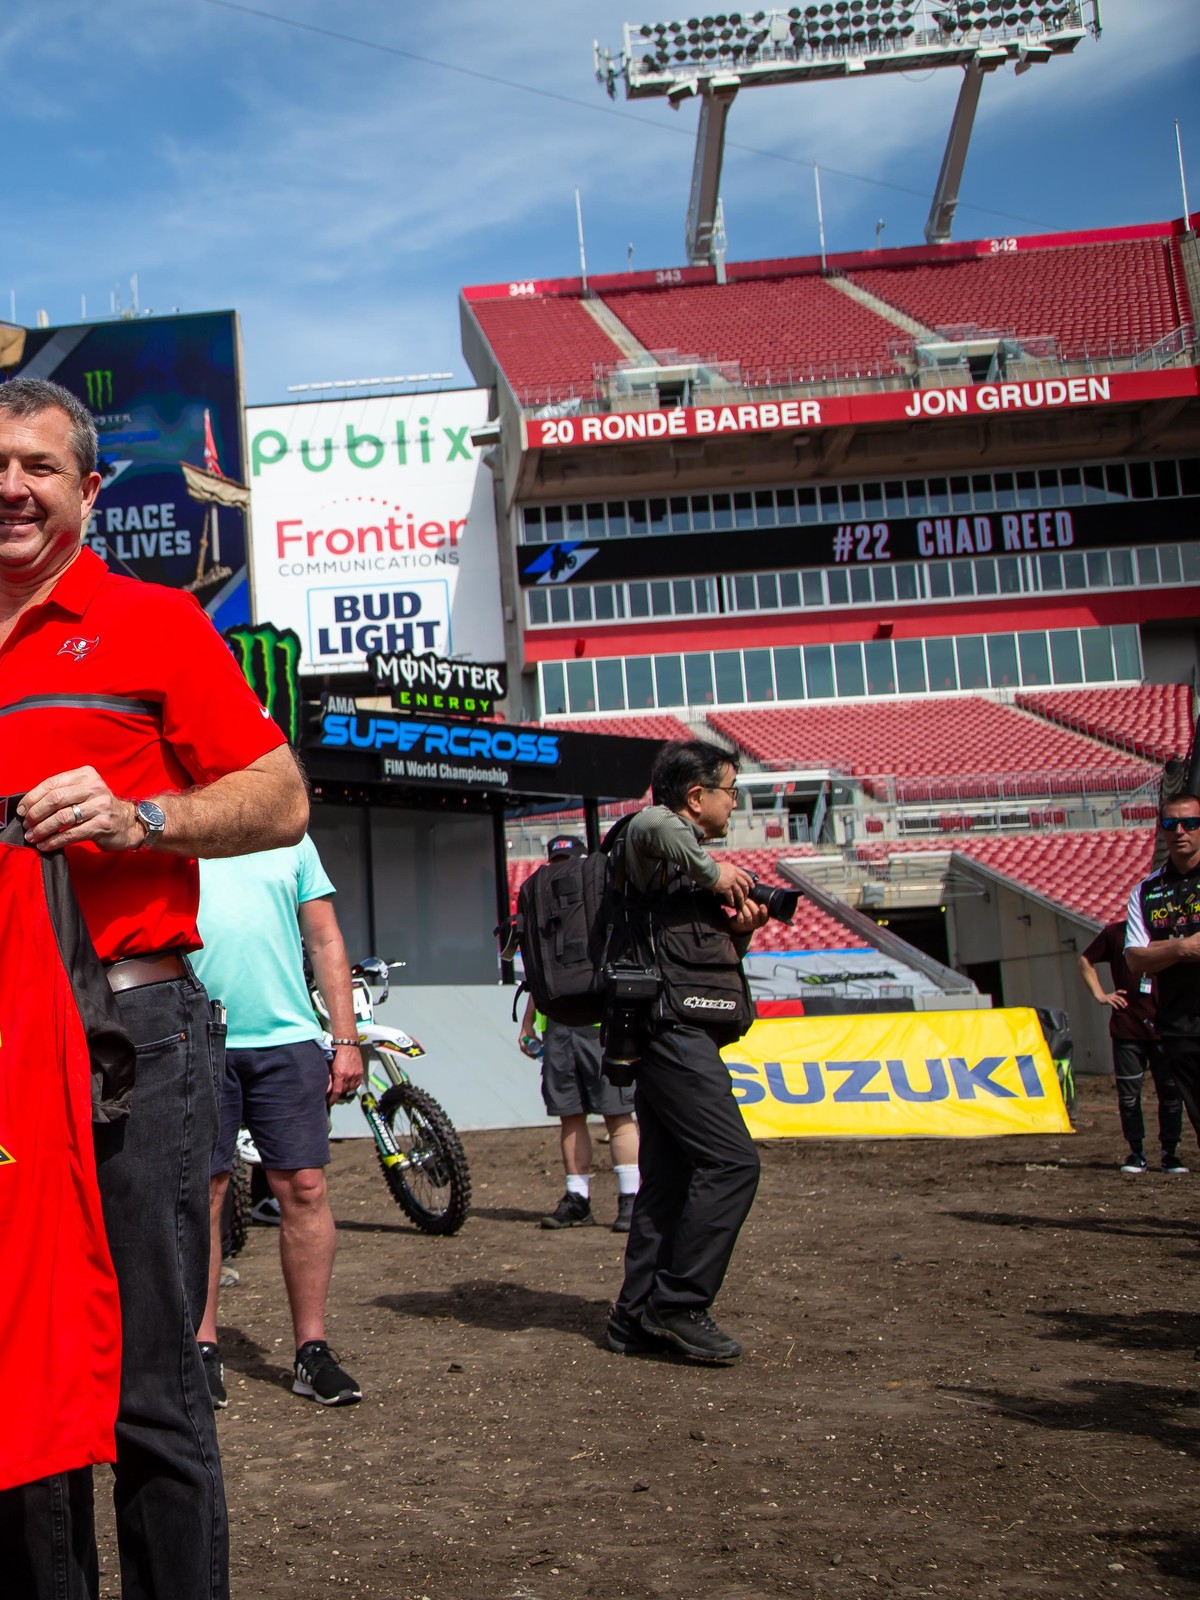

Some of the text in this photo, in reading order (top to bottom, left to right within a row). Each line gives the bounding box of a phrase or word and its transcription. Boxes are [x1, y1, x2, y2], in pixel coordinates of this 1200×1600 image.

[990, 238, 1018, 253] 342
[509, 282, 536, 297] 344
[655, 269, 683, 285] 343
[905, 376, 1111, 418] JON GRUDEN
[541, 400, 822, 445] 20 RONDÉ BARBER
[251, 416, 475, 477] Publix
[105, 503, 177, 534] RACE
[115, 530, 192, 561] LIVES
[276, 511, 468, 560] Frontier
[833, 510, 1075, 563] #22 CHAD REED
[278, 551, 461, 578] COMMUNICATIONS
[334, 591, 422, 624] BUD
[318, 620, 441, 656] LIGHT
[376, 653, 504, 695] MONSTER
[327, 695, 357, 716] AMA
[400, 690, 490, 714] ENERGY
[321, 714, 560, 766] SUPERCROSS
[384, 758, 509, 786] FIM World Championship
[727, 1054, 1045, 1105] SUZUKI
